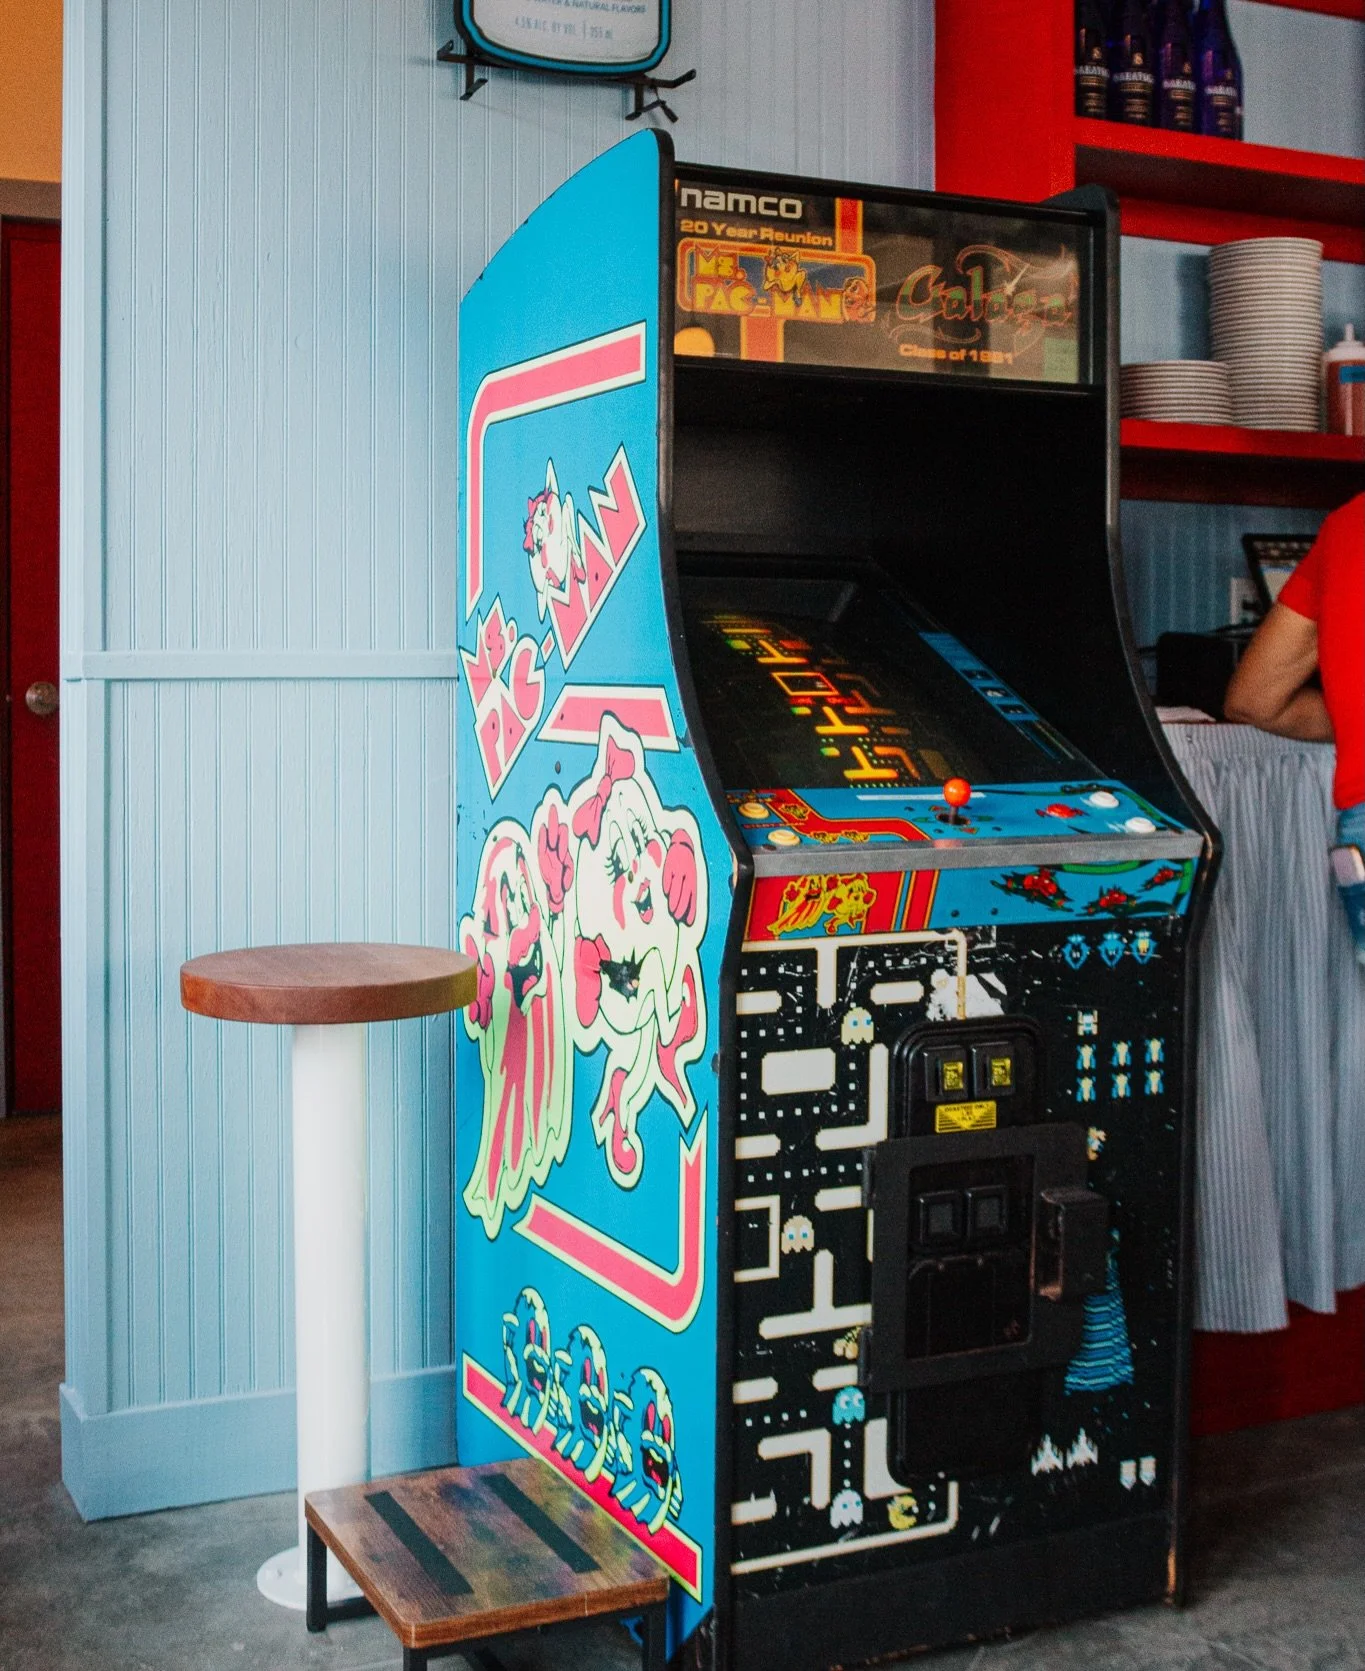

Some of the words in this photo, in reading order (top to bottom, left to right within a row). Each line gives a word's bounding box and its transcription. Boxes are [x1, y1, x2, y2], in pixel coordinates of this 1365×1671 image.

[572, 1, 610, 12] NATURAL
[612, 4, 647, 14] FLAVORS
[680, 187, 803, 219] namco
[680, 218, 709, 235] 20
[712, 221, 758, 240] Year
[760, 226, 834, 247] Reunion
[899, 343, 947, 359] Class
[948, 348, 966, 361] of
[968, 350, 1014, 366] 1981
